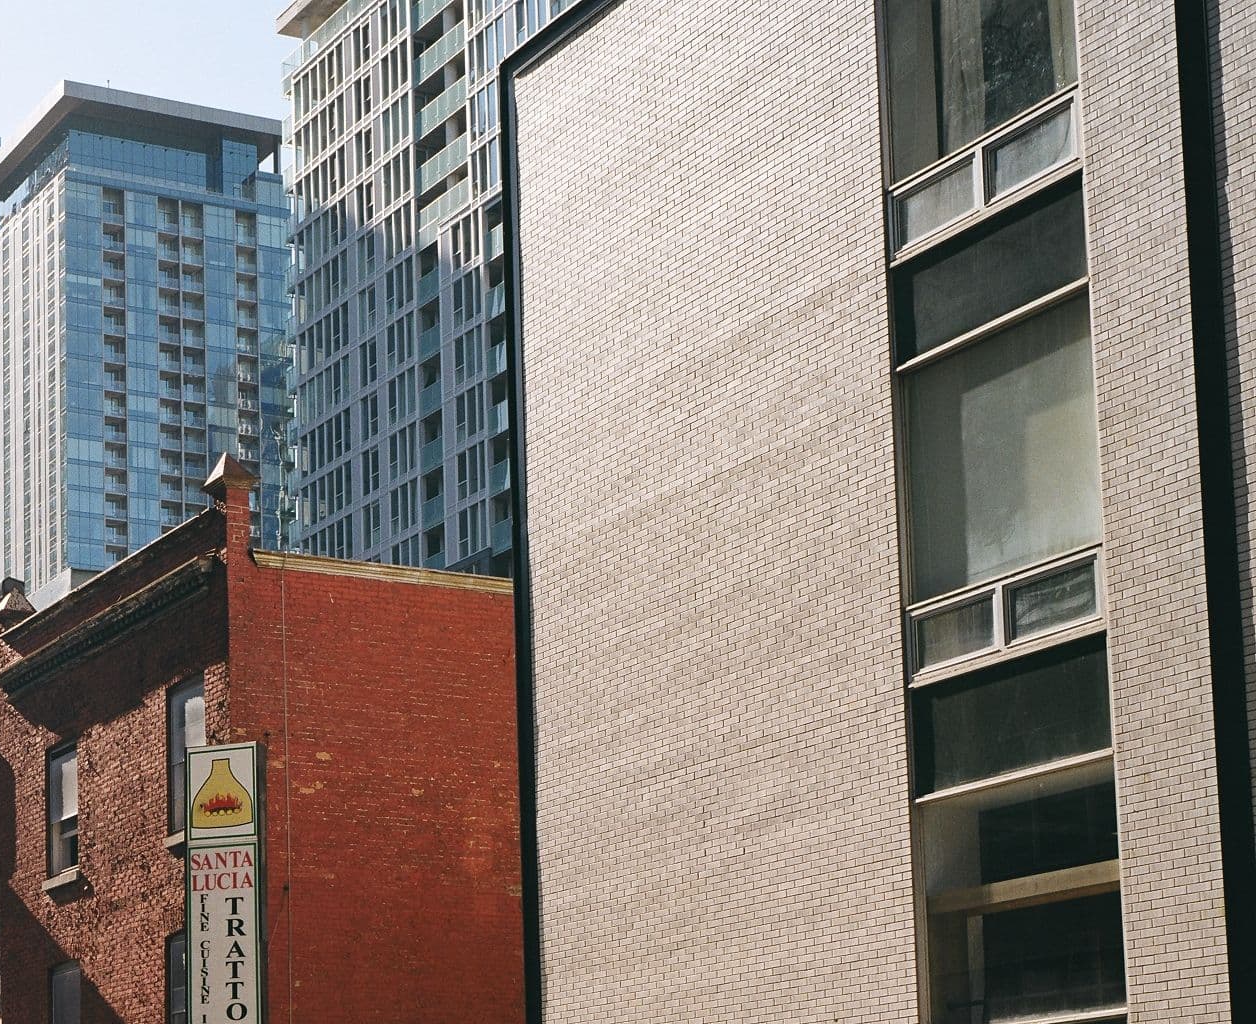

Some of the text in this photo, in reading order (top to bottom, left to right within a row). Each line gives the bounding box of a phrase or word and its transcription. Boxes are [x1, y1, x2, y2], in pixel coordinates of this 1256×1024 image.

[191, 851, 253, 870] SANTA
[192, 872, 253, 891] LUCIA
[200, 894, 209, 932] FINE
[200, 940, 210, 1004] CUISINE
